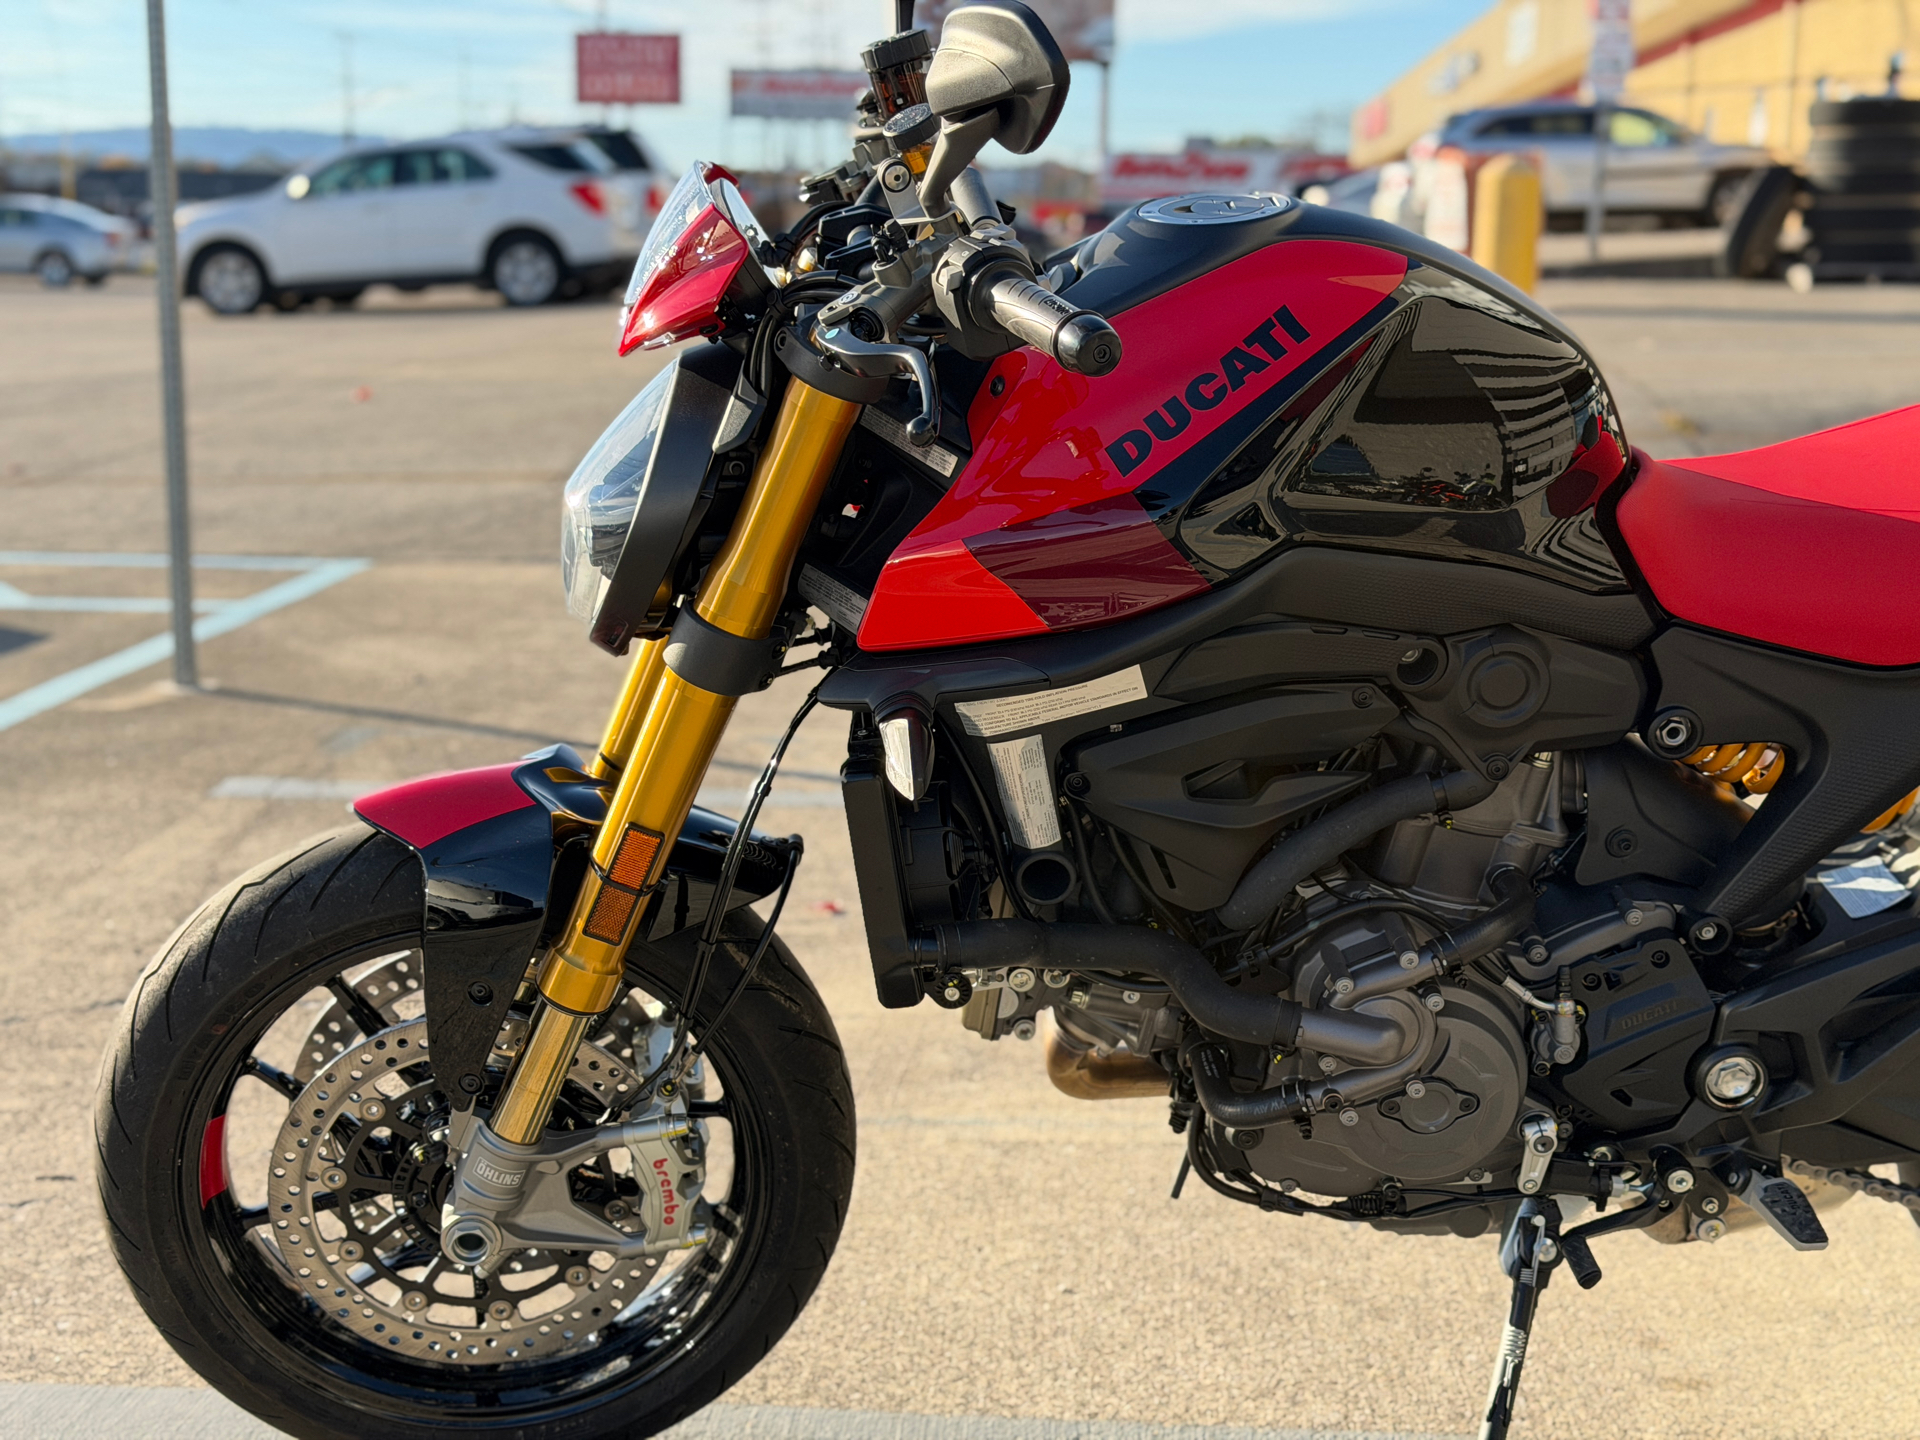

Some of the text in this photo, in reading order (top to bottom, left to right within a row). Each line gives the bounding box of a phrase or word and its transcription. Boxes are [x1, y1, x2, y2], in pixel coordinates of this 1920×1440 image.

[1104, 304, 1311, 478] DUCATI
[1621, 1001, 1678, 1030] DUCATI
[476, 1160, 521, 1185] ÖHLINS
[653, 1158, 679, 1225] brembo
